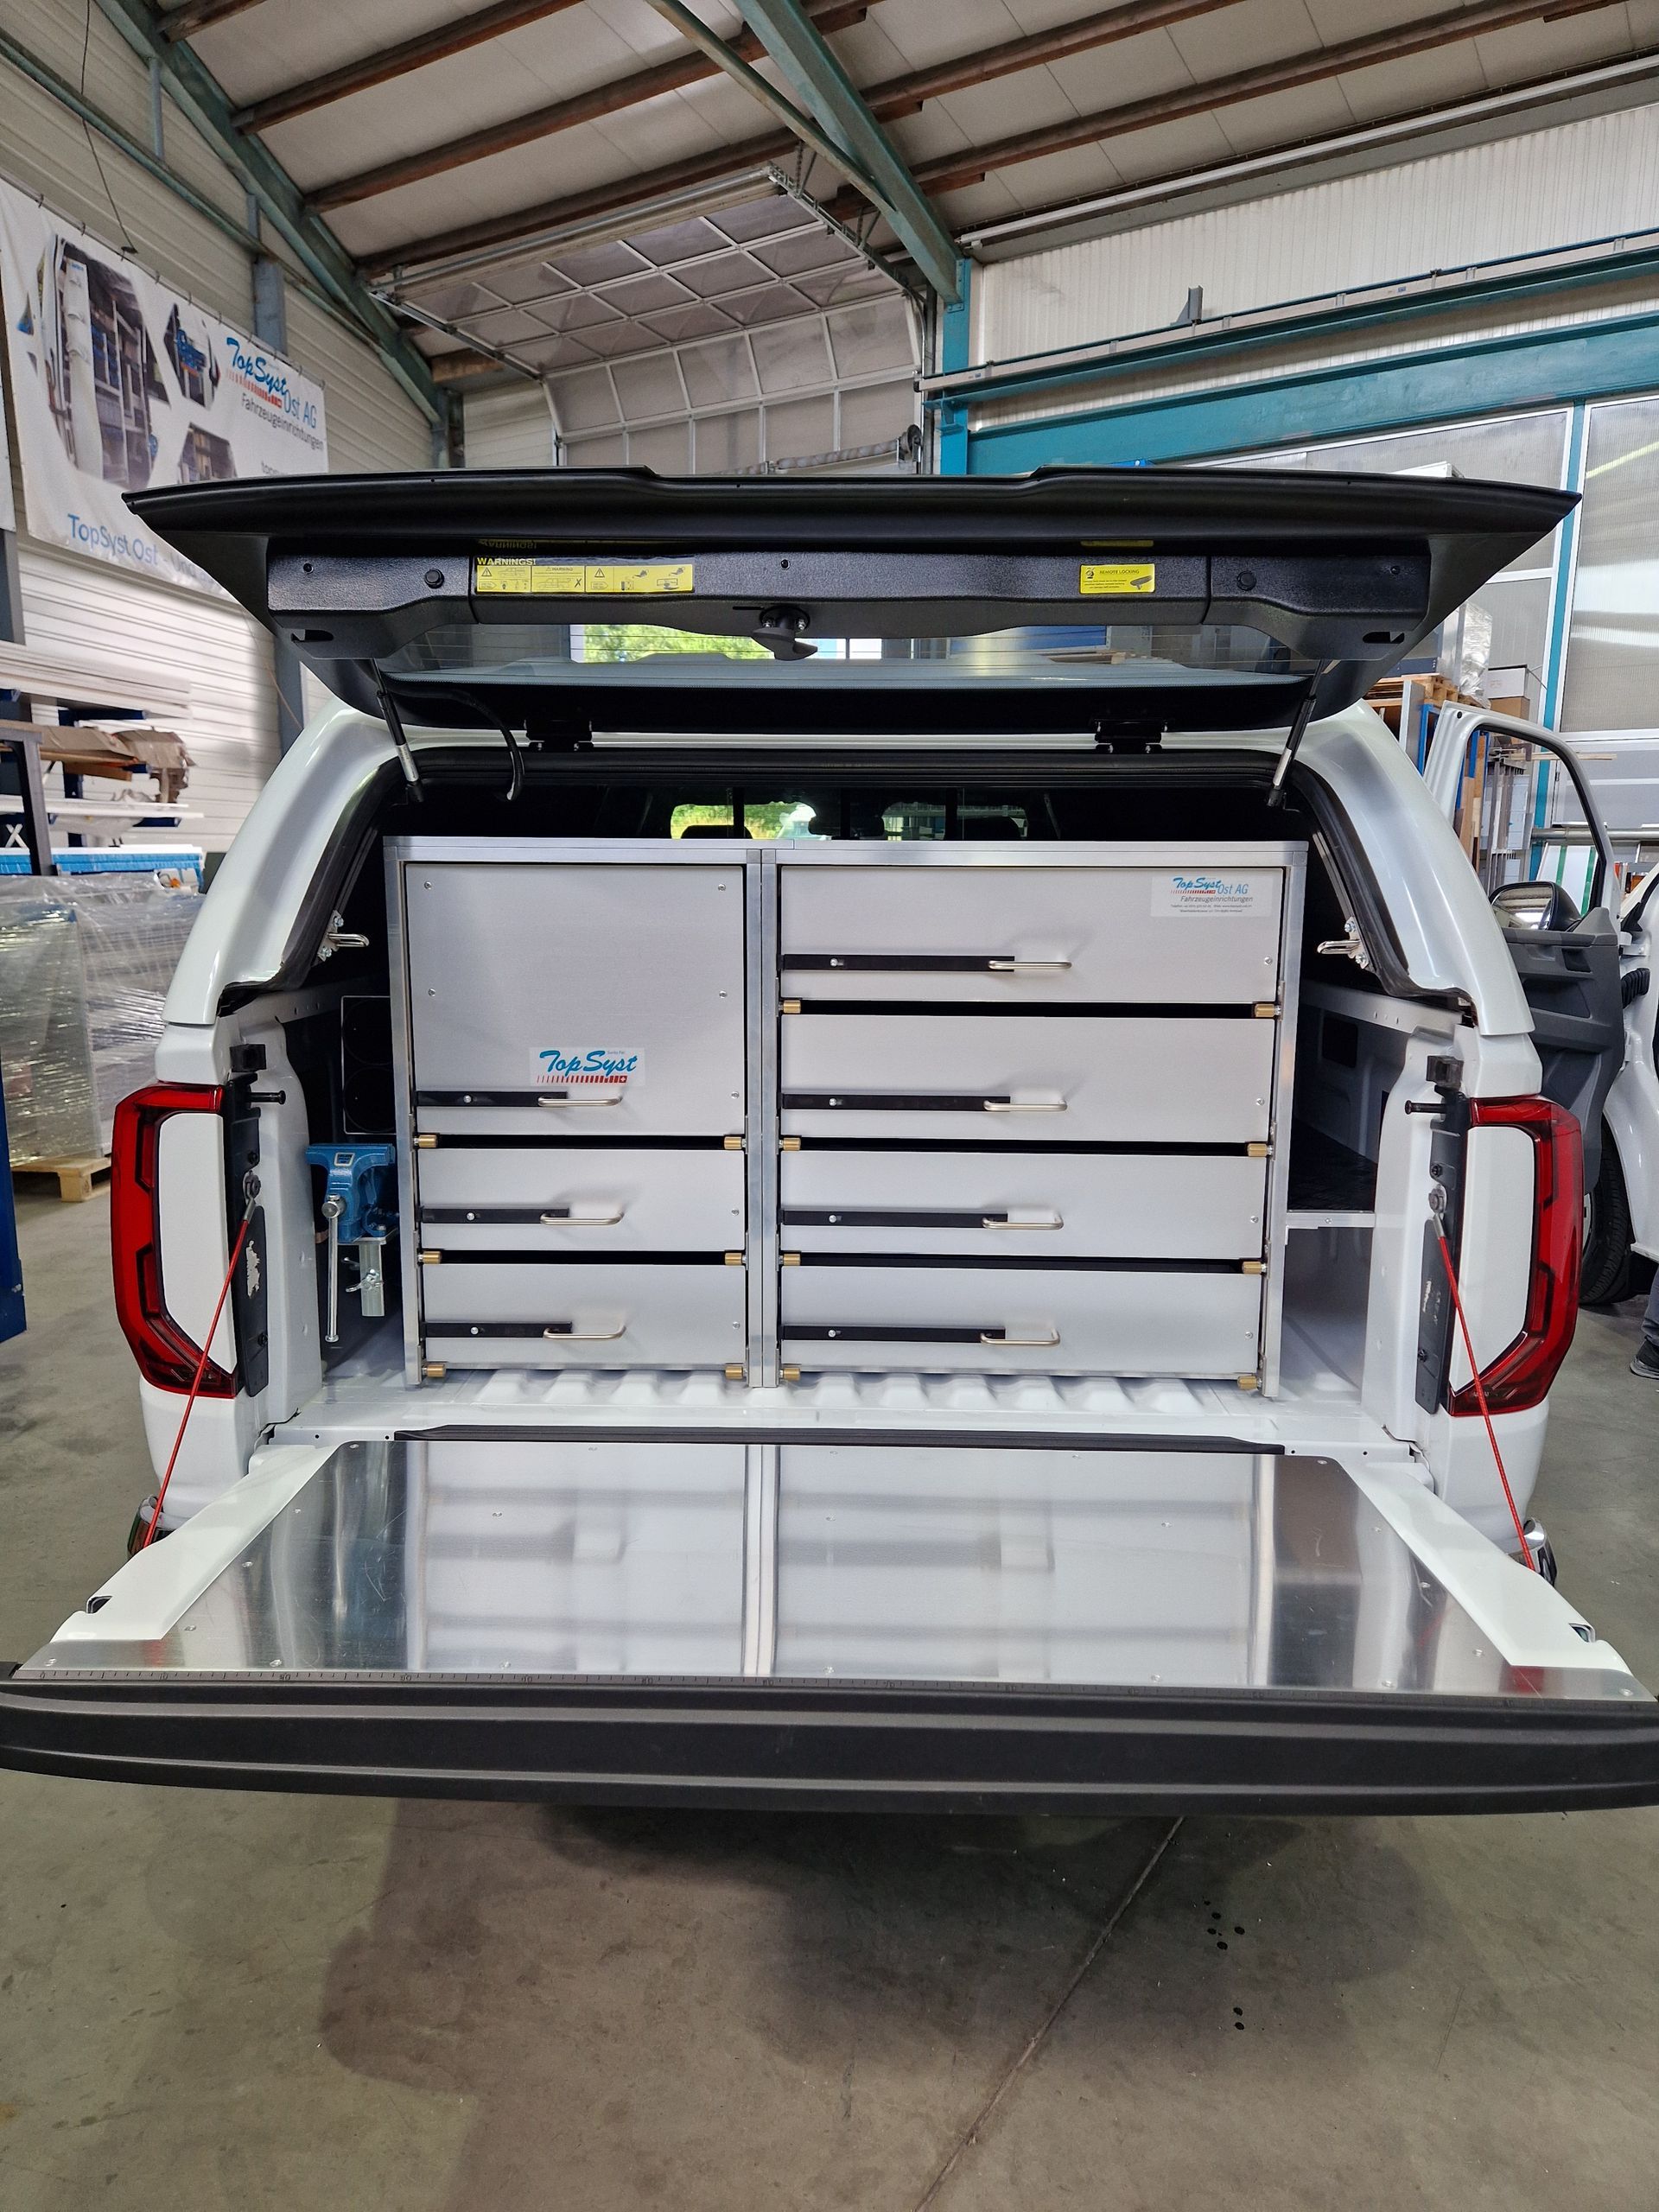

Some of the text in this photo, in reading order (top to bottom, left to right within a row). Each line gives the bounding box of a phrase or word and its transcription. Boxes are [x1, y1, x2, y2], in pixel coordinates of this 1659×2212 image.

[226, 337, 317, 429] TopSyst Ost AG
[242, 392, 324, 450] Fahrzeugeinrichtungen
[67, 513, 131, 556] TopSyst
[133, 538, 158, 565] Ost
[477, 557, 537, 566] WARNINGS!
[1173, 877, 1249, 894] TopSyst Ost AG
[1180, 895, 1254, 904] Fahrzeugeinrichtungen
[539, 1050, 638, 1077] TopSyst
